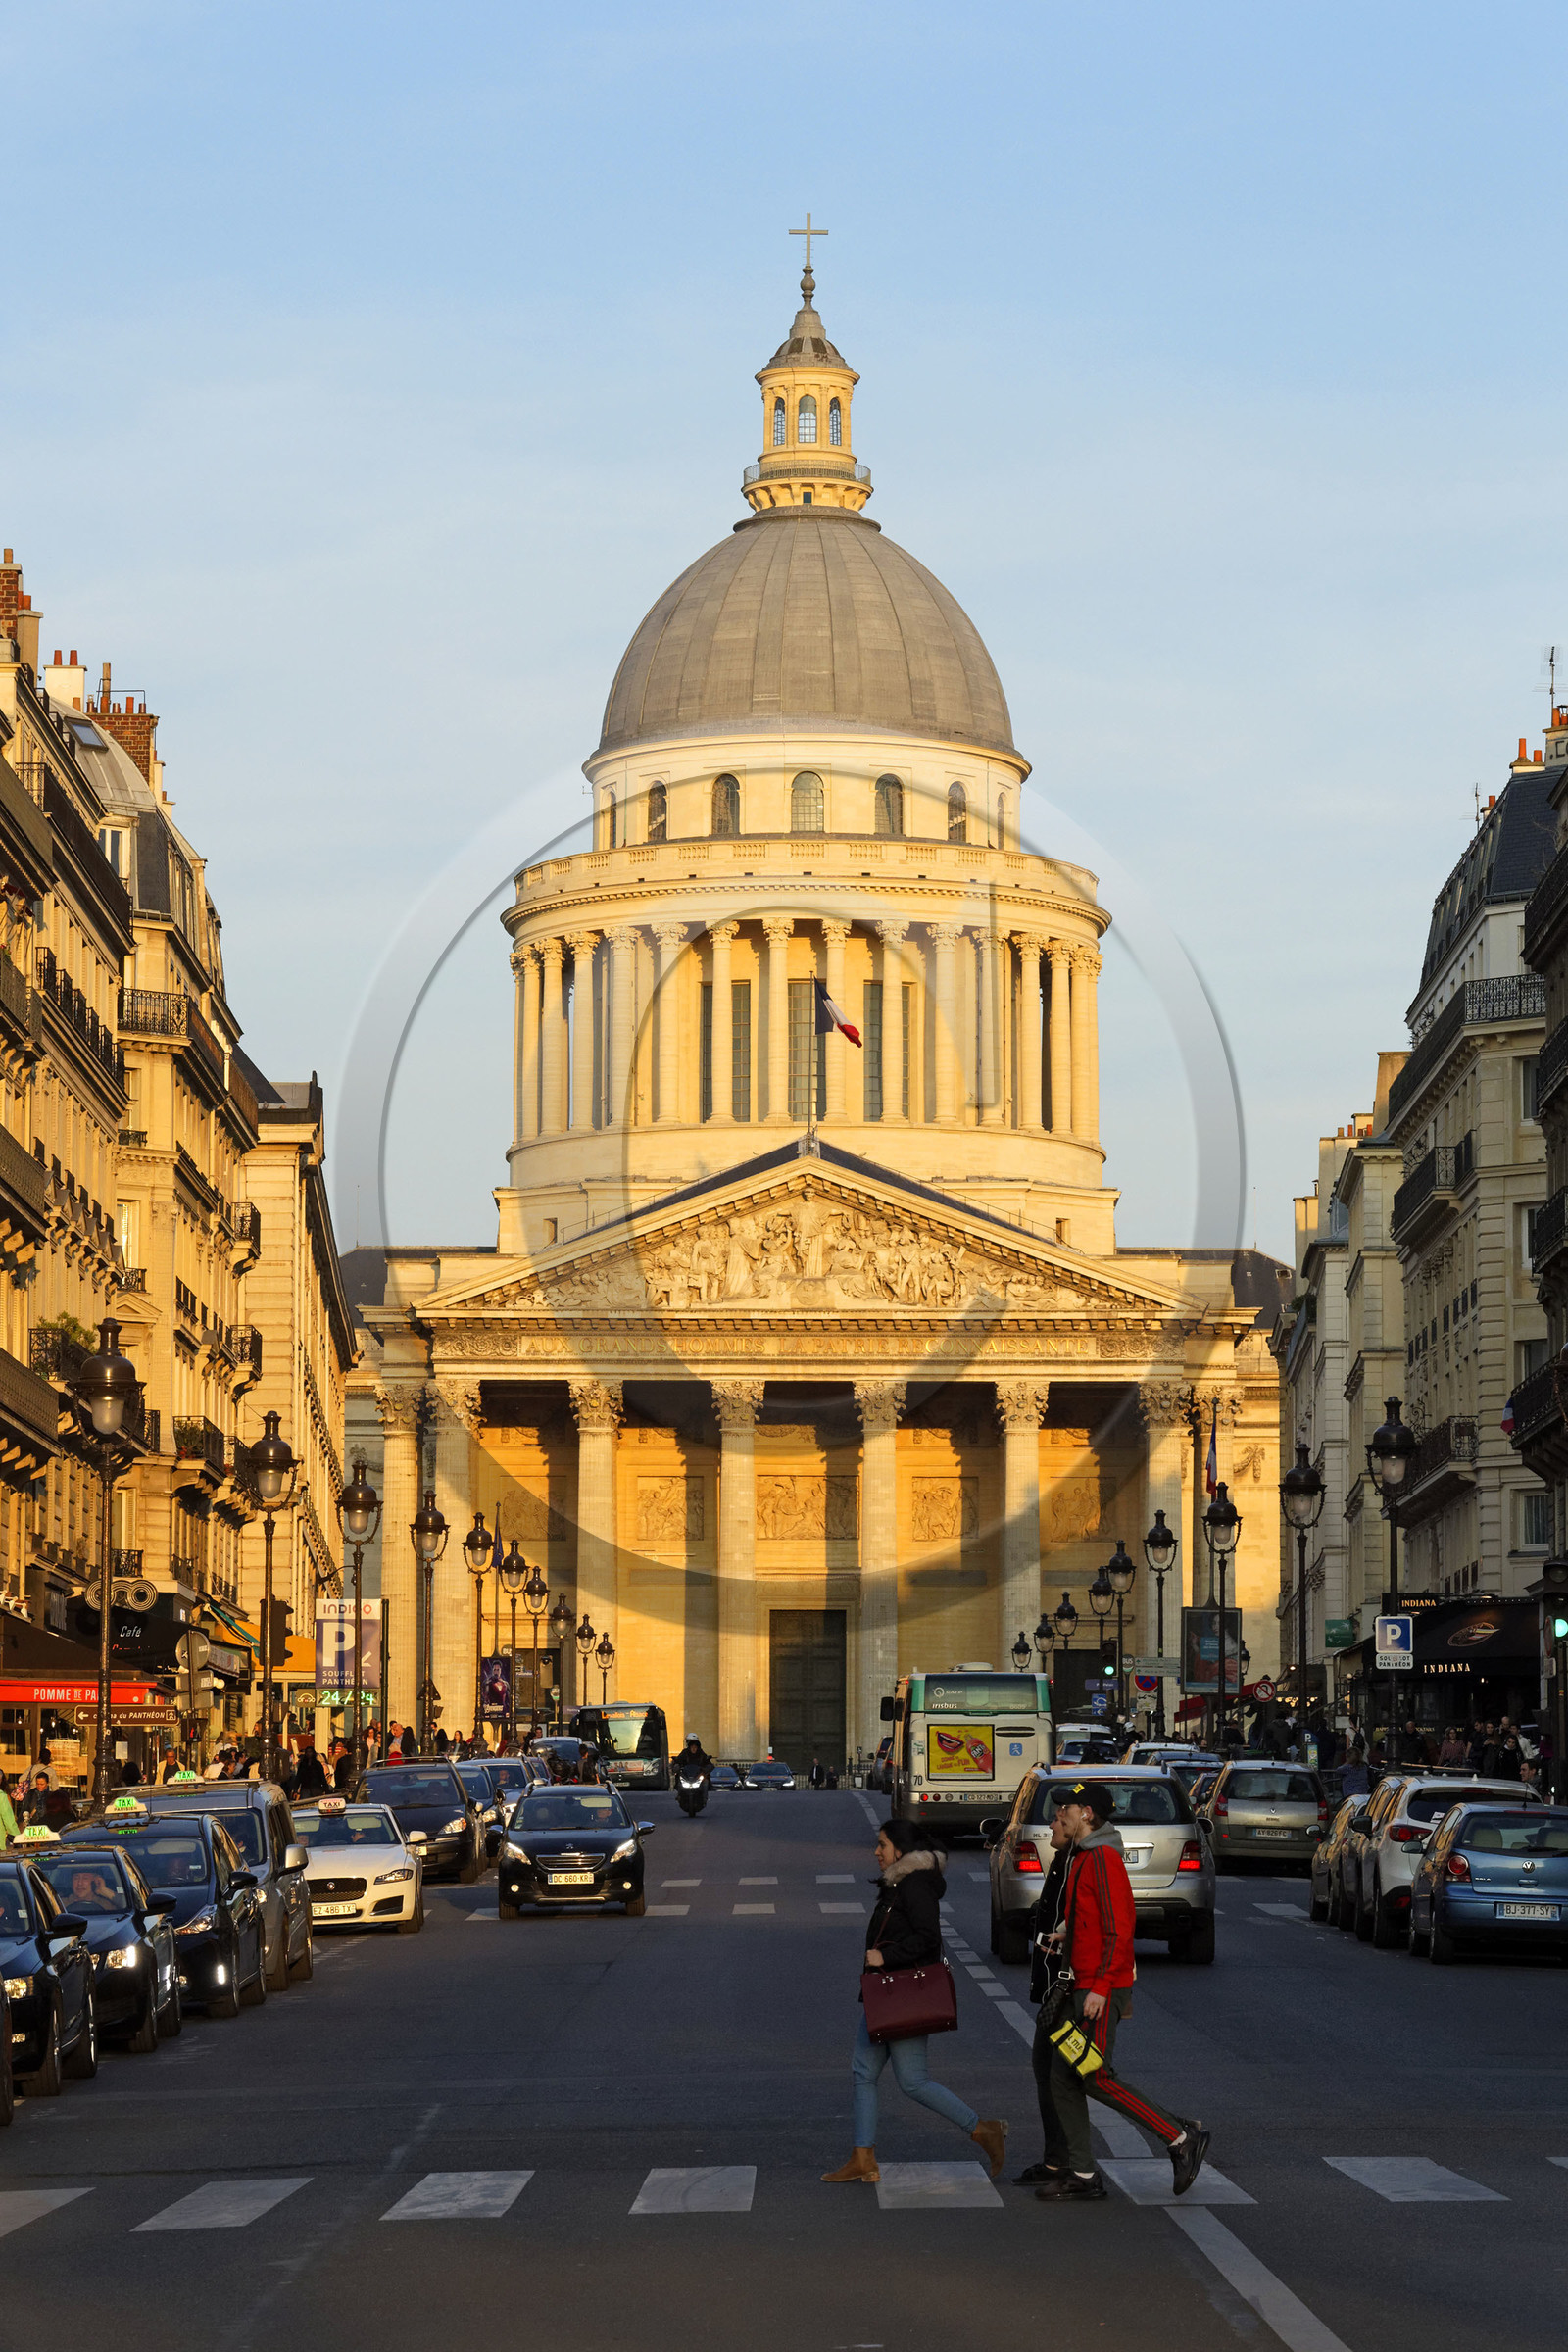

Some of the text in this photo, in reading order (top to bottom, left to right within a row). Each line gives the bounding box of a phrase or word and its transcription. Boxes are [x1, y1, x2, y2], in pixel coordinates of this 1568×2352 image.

[526, 1338, 1089, 1353] AUX GRANDS HOMMES LA PATRIE RECONNAISSANTE
[120, 1625, 142, 1638] Café
[1387, 1624, 1402, 1645] P
[1424, 1663, 1471, 1674] INDIANA
[322, 1677, 368, 1686] PANTHÉN
[34, 1688, 71, 1700] POMME
[74, 1690, 82, 1699] DE
[913, 1775, 923, 1785] 70
[118, 1797, 135, 1807] TAXI
[25, 1826, 47, 1837] TAXI
[1505, 1905, 1550, 1916] BJ-377-SY
